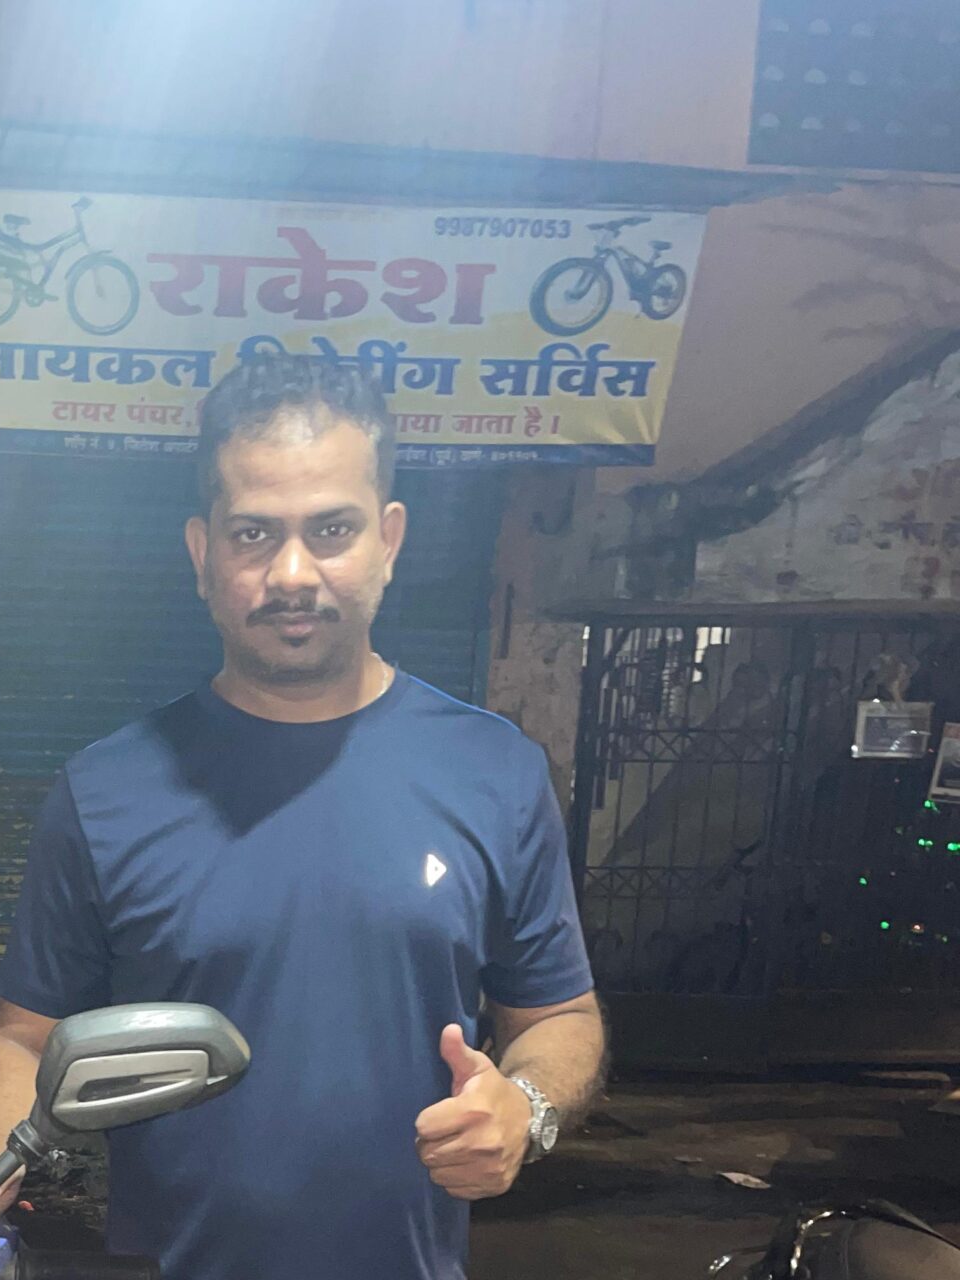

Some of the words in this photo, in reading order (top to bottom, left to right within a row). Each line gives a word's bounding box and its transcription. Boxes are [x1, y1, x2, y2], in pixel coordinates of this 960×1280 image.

[434, 216, 572, 239] 9987907053
[146, 226, 497, 325] राकेश
[479, 342, 657, 397] सर्विस
[52, 400, 116, 423] टायर
[451, 413, 518, 435] जाता
